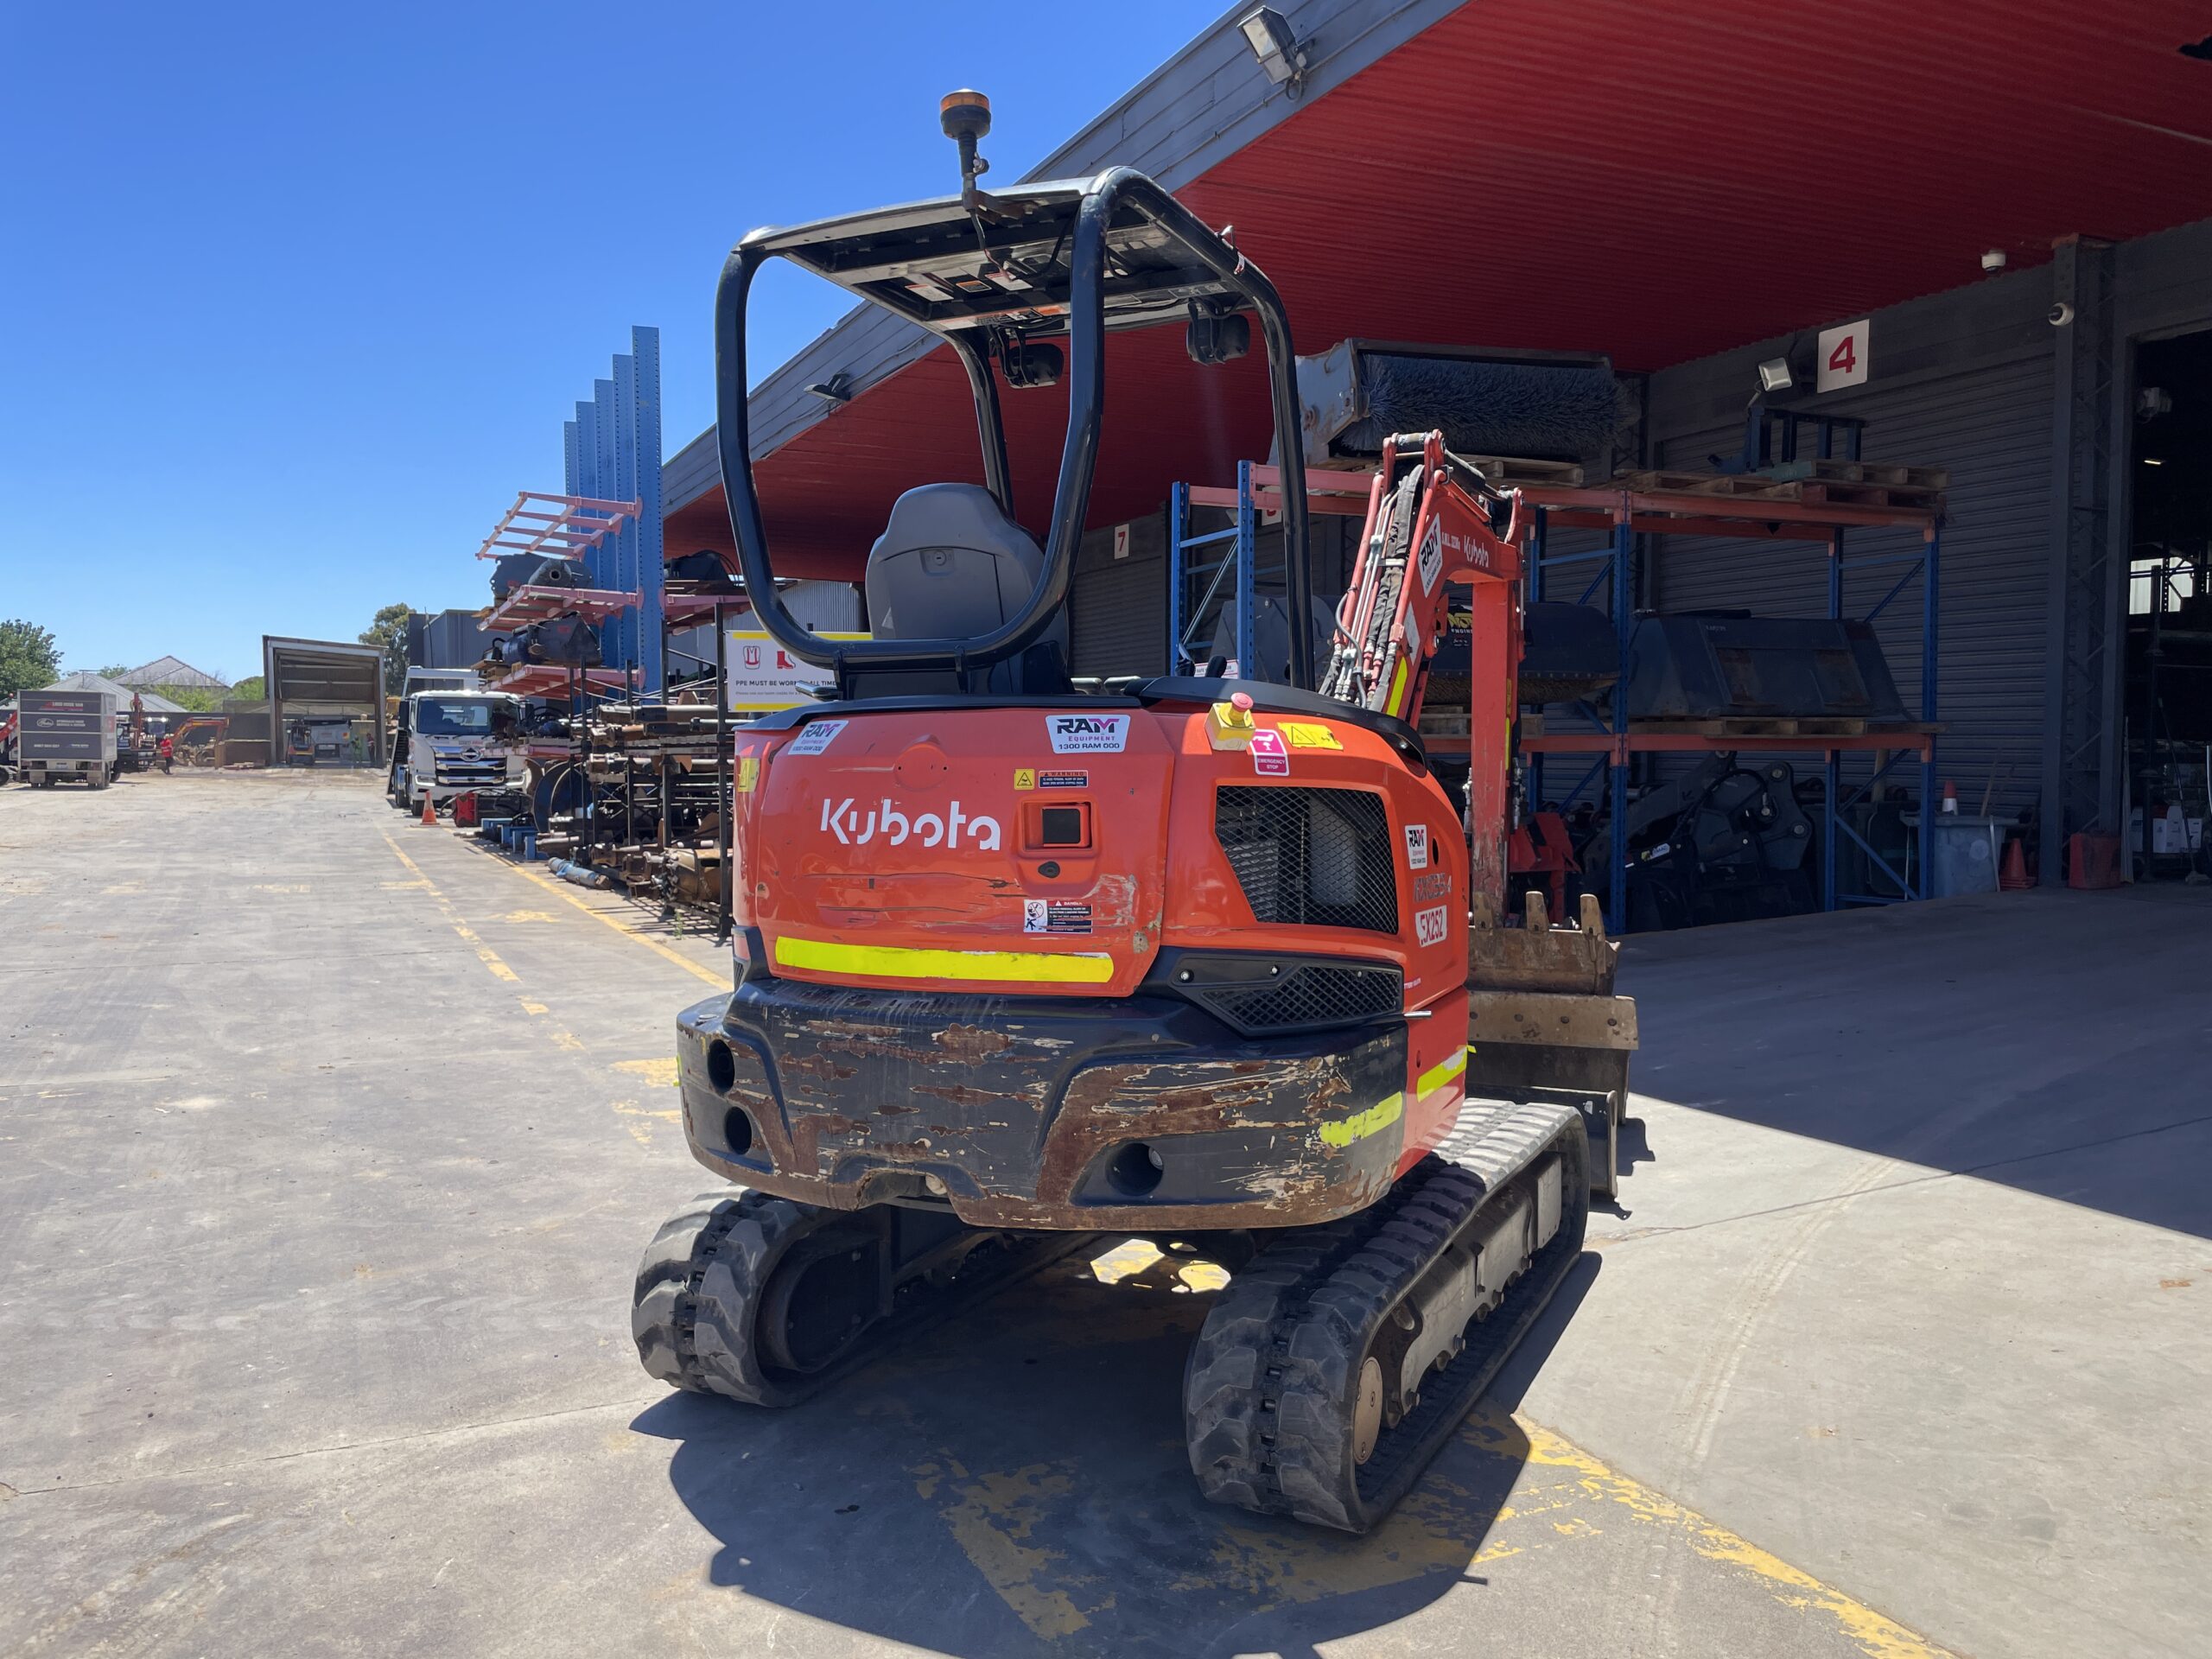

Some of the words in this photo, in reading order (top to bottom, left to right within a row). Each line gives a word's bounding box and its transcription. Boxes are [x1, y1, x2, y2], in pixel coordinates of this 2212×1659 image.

[1829, 335, 1856, 374] 4
[1117, 531, 1126, 551] 7
[1464, 534, 1489, 568] Kubota
[802, 723, 841, 738] RAM
[1056, 718, 1120, 734] RAM
[821, 798, 1001, 851] Kubota
[1408, 830, 1425, 847] RAM
